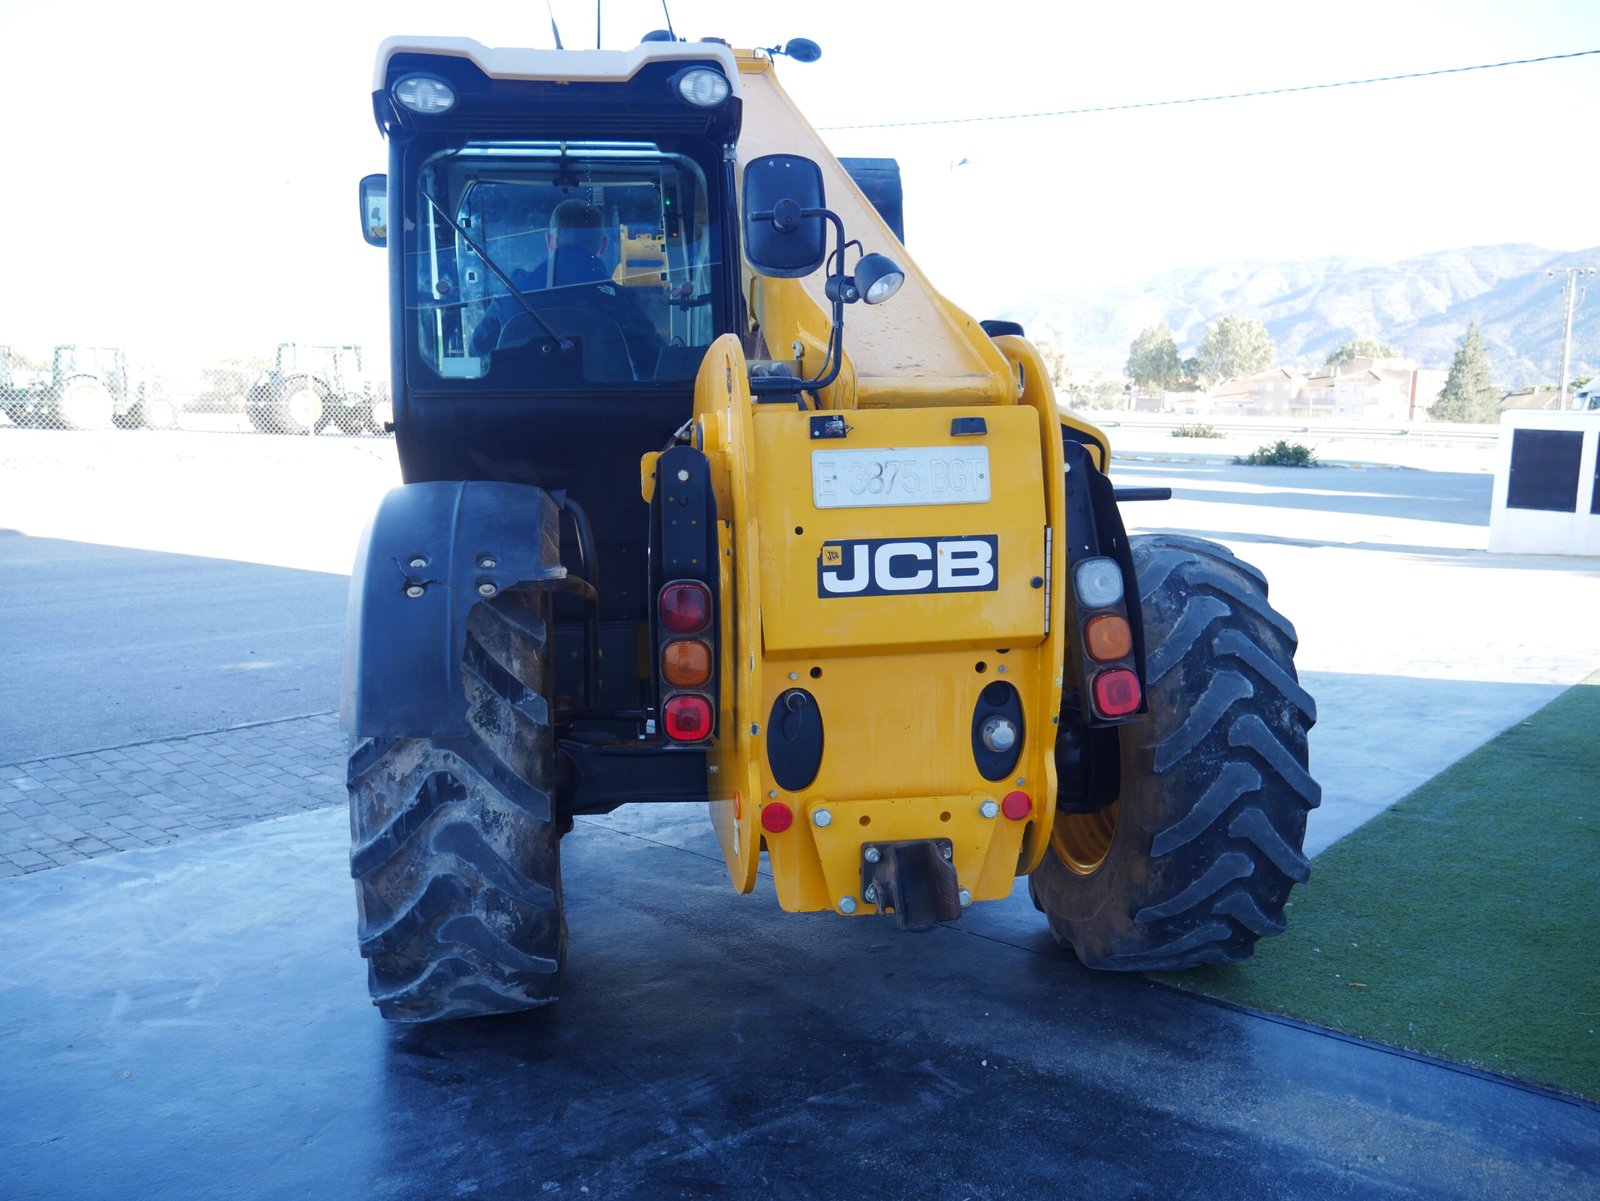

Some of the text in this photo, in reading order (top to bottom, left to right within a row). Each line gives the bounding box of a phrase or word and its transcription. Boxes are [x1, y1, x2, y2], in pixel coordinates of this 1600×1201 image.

[818, 458, 983, 496] E 3875 BGT
[823, 540, 994, 593] JCB
